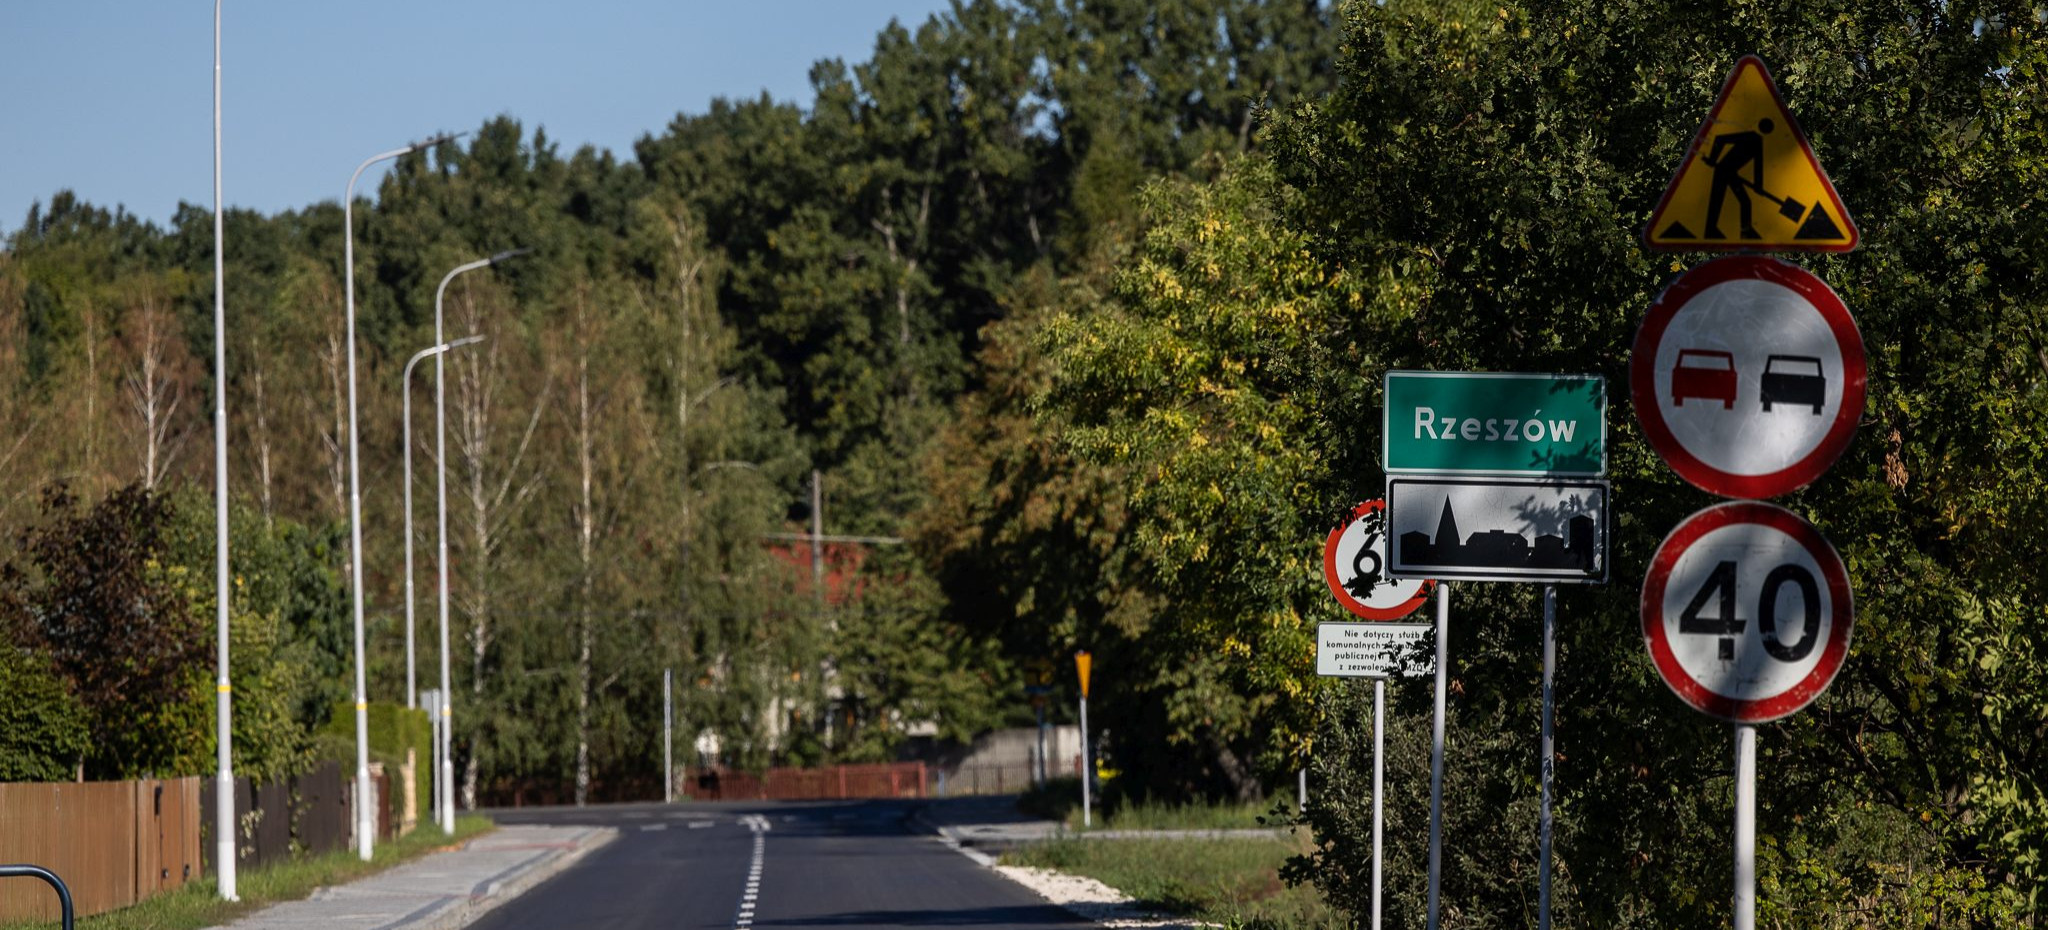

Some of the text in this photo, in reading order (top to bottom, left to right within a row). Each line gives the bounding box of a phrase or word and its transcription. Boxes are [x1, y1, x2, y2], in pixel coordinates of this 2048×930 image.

[1414, 406, 1577, 443] Rzeszów
[1679, 560, 1822, 663] 40
[1344, 630, 1420, 640] Nie dotyczy służb
[1326, 640, 1381, 651] komunalnych
[1334, 652, 1377, 662] publicznej
[1348, 663, 1397, 672] zezwoleni
